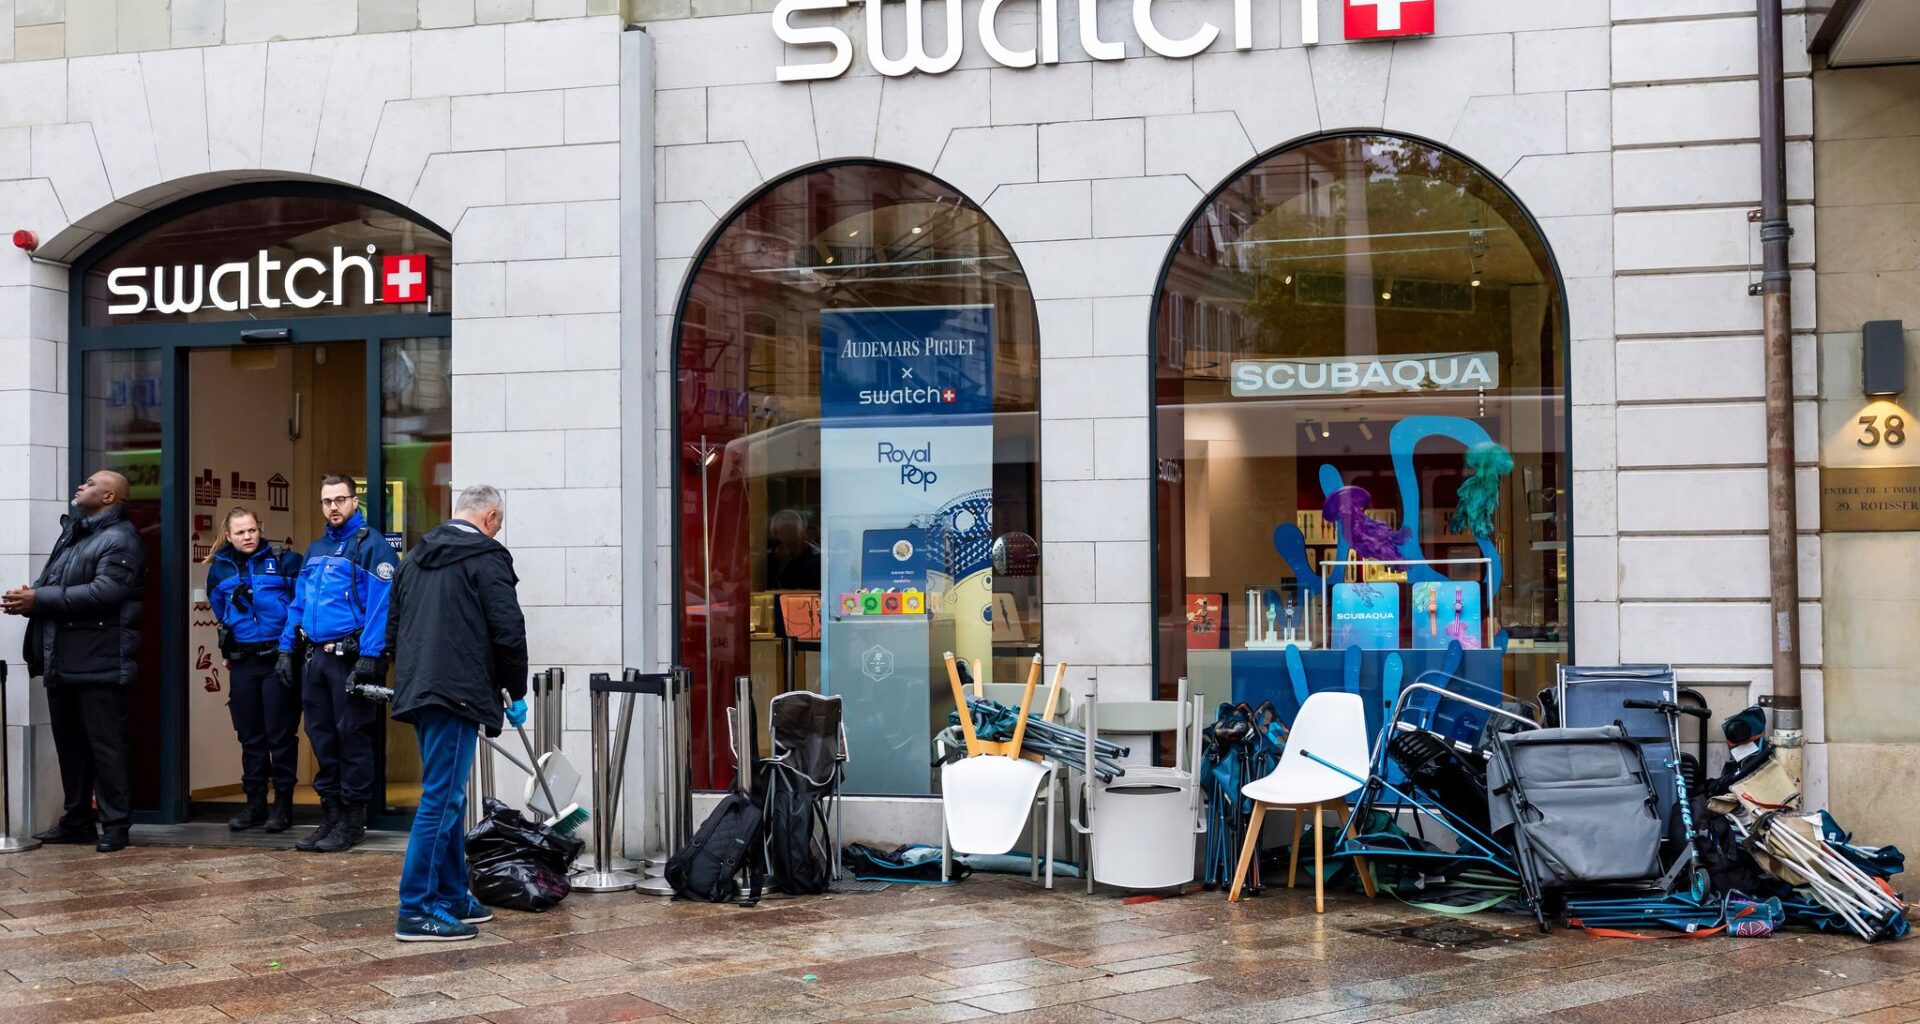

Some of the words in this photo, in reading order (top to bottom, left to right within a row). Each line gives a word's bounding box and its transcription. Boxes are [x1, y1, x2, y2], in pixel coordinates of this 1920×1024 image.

[107, 246, 374, 315] swatch
[841, 339, 920, 358] AUDEMARS
[925, 337, 976, 356] PIGUET
[1236, 357, 1492, 391] SCUBAQUA
[859, 386, 941, 404] swatch
[1857, 414, 1906, 447] 38
[878, 441, 931, 470] Royal
[1336, 612, 1395, 620] SCUBAQUA
